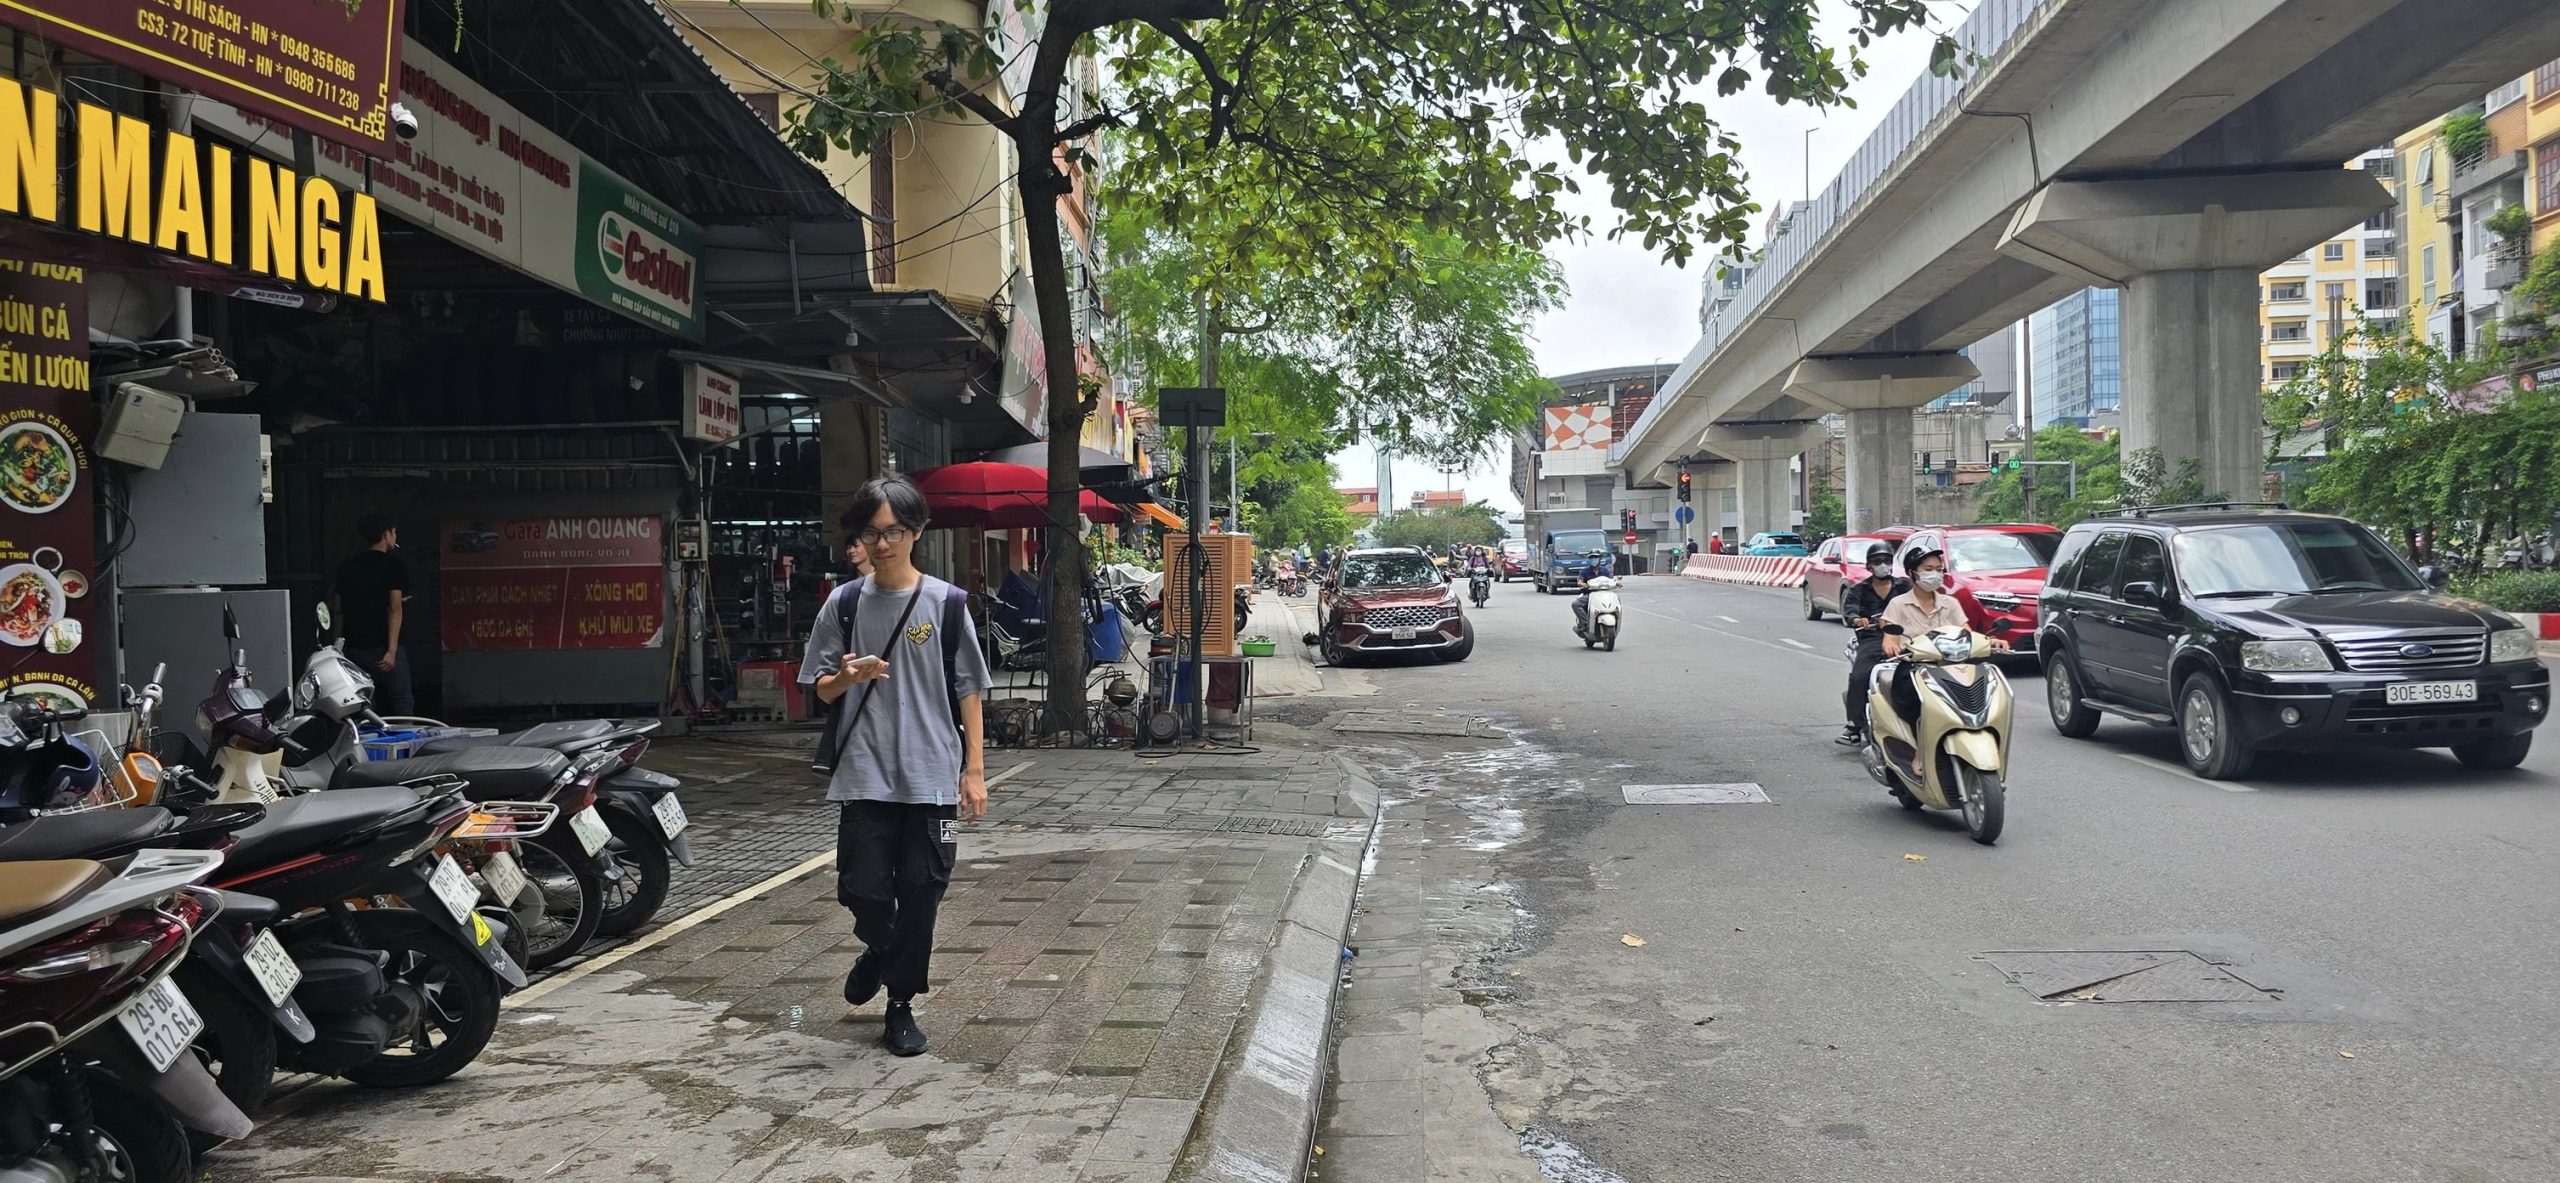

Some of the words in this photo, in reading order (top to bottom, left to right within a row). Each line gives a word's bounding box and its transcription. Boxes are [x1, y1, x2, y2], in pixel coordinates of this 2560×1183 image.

[137, 9, 168, 38] CS3:
[171, 21, 188, 46] 72
[191, 28, 215, 59] TUỆ
[218, 38, 246, 67] TĨNH
[256, 54, 272, 78] HN
[285, 66, 314, 94] 0988
[316, 78, 337, 103] 711
[339, 88, 359, 111] 238
[208, 5, 241, 34] SÁCH
[251, 21, 268, 46] HN
[280, 35, 309, 63] 0948
[312, 48, 334, 73] 355
[335, 57, 356, 81] 686
[77, 98, 233, 266] MAI
[249, 154, 387, 304] NGA
[624, 230, 691, 305] Castrol
[41, 302, 71, 341] CÁ
[34, 354, 90, 392] LƯƠN
[546, 517, 582, 539] ANH
[587, 516, 650, 539] QUANG
[637, 615, 654, 634] XE
[2389, 683, 2474, 702] 30E-569.43
[146, 1005, 197, 1065] 012.64
